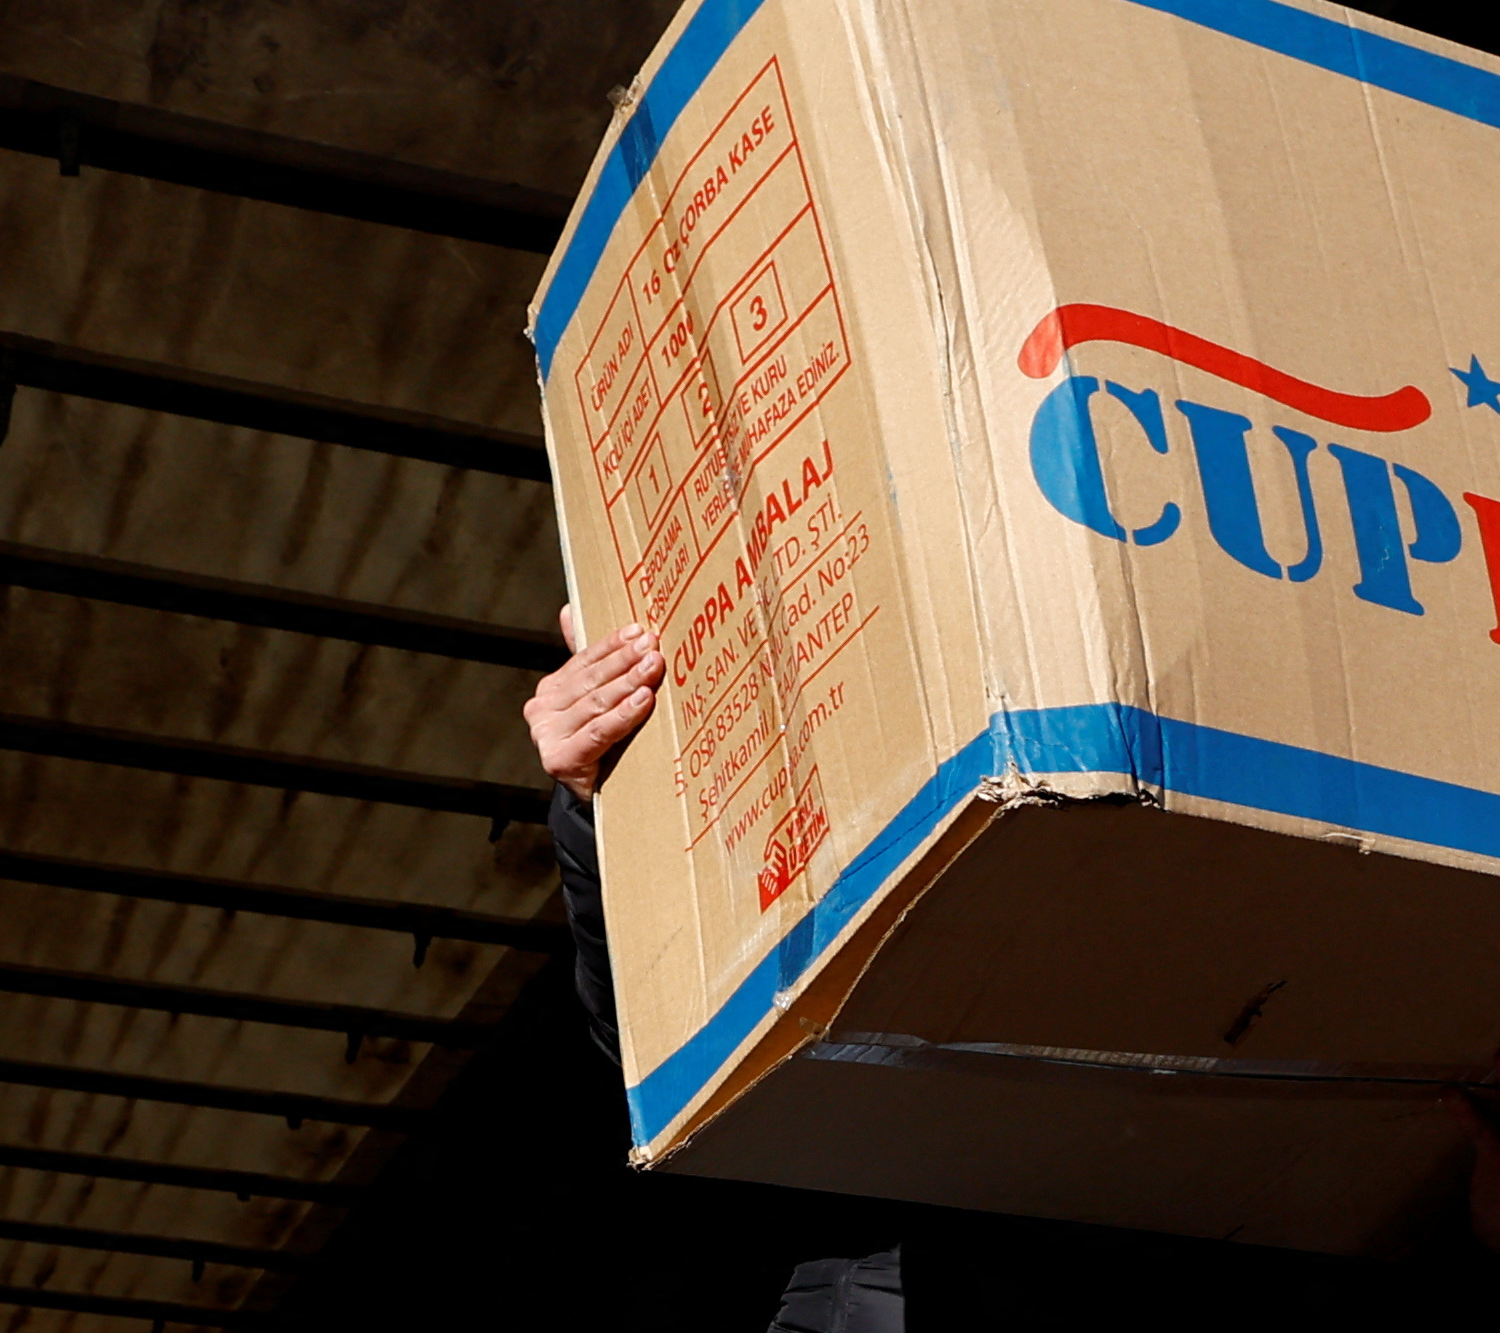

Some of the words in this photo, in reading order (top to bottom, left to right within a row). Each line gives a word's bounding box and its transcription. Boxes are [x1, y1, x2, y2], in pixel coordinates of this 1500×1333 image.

[643, 269, 661, 303] 16
[680, 166, 729, 245] ÇORBA
[729, 107, 774, 173] KASE
[662, 309, 695, 367] 1000
[751, 296, 767, 331] 3
[591, 354, 620, 412] ÜRÜN
[617, 322, 635, 360] ADI
[698, 382, 713, 417] 2
[736, 392, 752, 418] VE
[752, 356, 788, 400] KURU
[738, 388, 797, 464] MUHAFAZA
[796, 341, 840, 398] EDİNİZ.
[602, 442, 624, 478] KOLİ
[619, 417, 636, 450] İÇİ
[632, 377, 650, 423] ADET
[648, 465, 660, 494] 1
[639, 515, 683, 598] DEPOLAMA
[646, 547, 689, 623] KOŞULLARI
[675, 583, 734, 687] CUPPA
[735, 438, 834, 599] AMBALAJ
[683, 683, 708, 730] İNŞ.
[705, 647, 736, 694] SAN.
[737, 608, 759, 647] VE
[770, 536, 807, 586] LTD.
[806, 493, 844, 549] ŞTİ.
[699, 709, 770, 819] Şehitkamil
[770, 696, 777, 731] /
[777, 592, 853, 712] GAZİANTEP
[716, 672, 760, 741] 83528
[758, 634, 784, 687] Nolu
